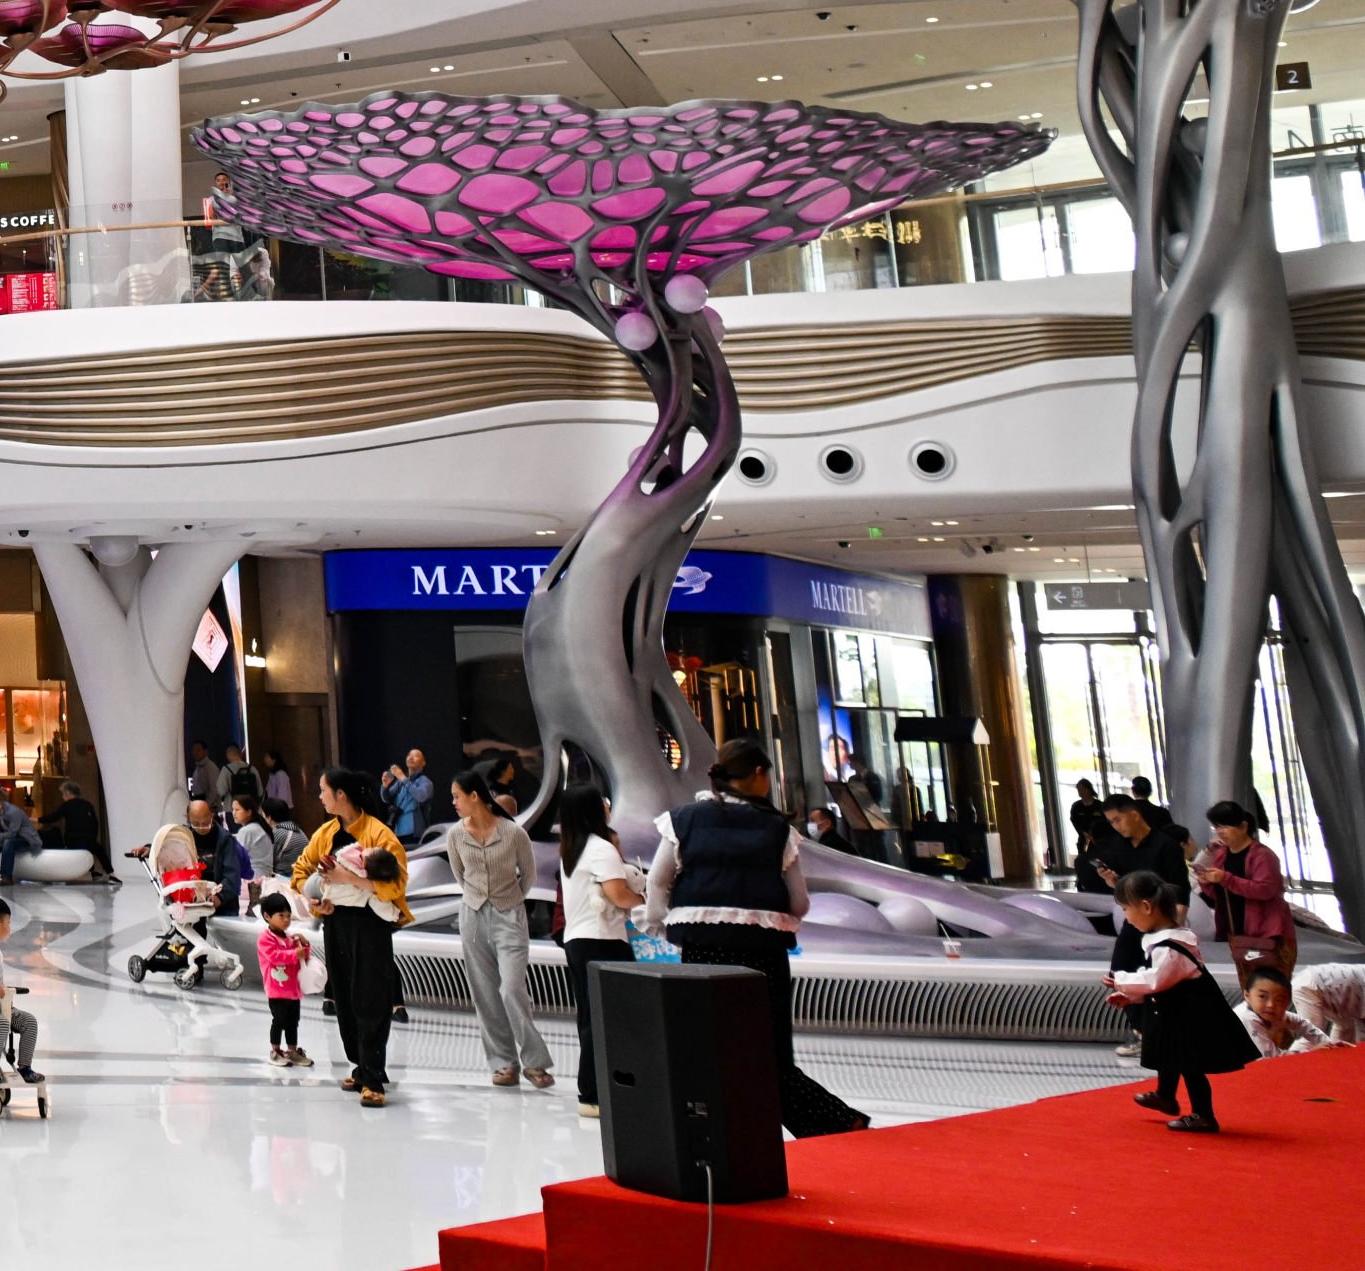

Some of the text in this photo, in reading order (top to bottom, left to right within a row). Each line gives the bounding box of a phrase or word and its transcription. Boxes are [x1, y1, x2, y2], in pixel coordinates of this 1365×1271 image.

[10, 214, 55, 228] COFFE
[411, 565, 549, 595] MART
[810, 580, 867, 616] MARTELL
